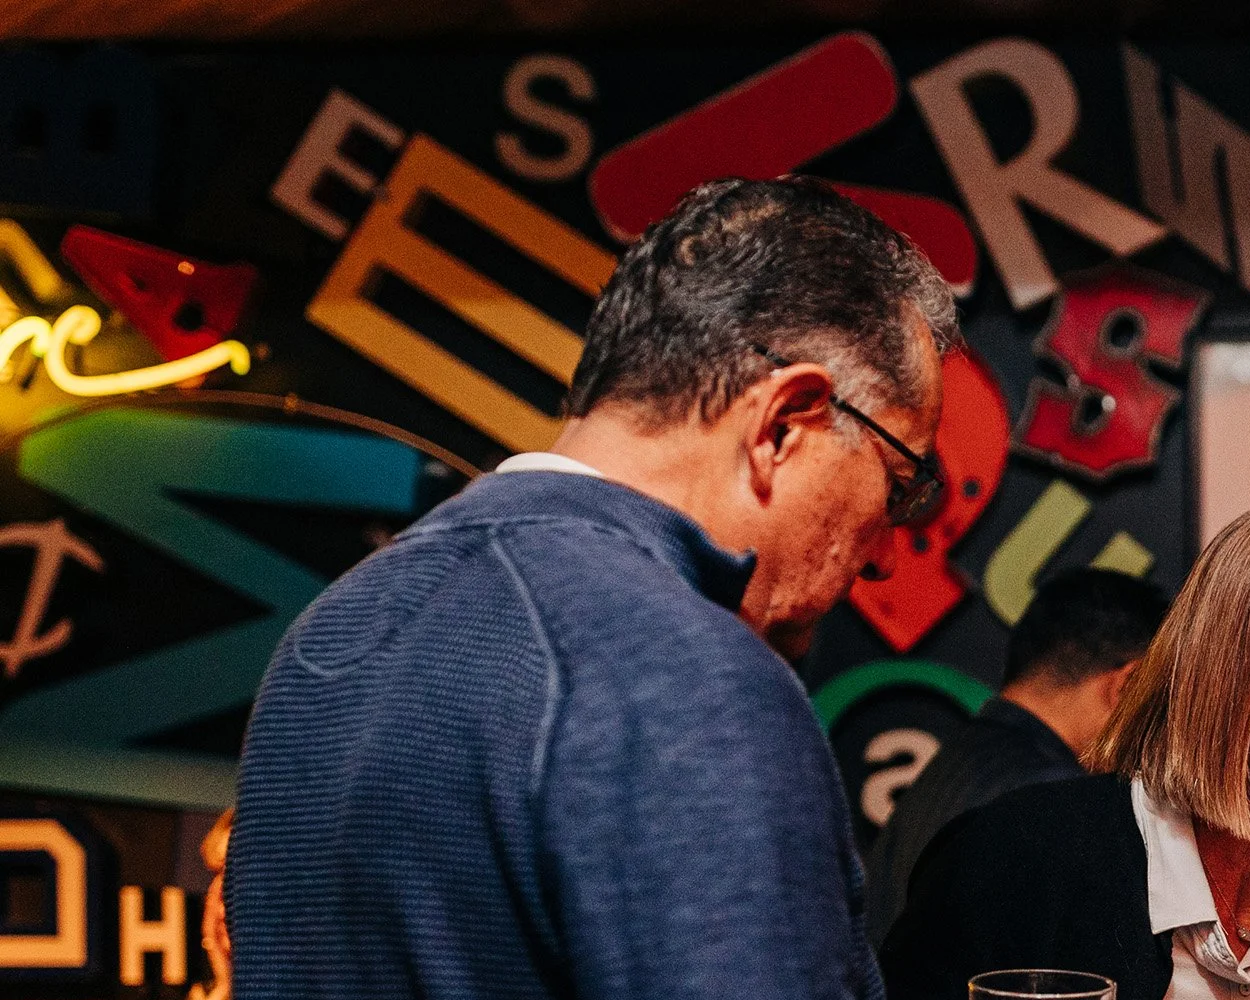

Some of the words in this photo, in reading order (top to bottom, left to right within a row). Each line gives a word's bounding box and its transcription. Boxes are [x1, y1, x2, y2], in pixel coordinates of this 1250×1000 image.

[496, 50, 600, 183] S
[907, 35, 1168, 311] R
[1015, 263, 1208, 484] S
[117, 883, 189, 988] H
